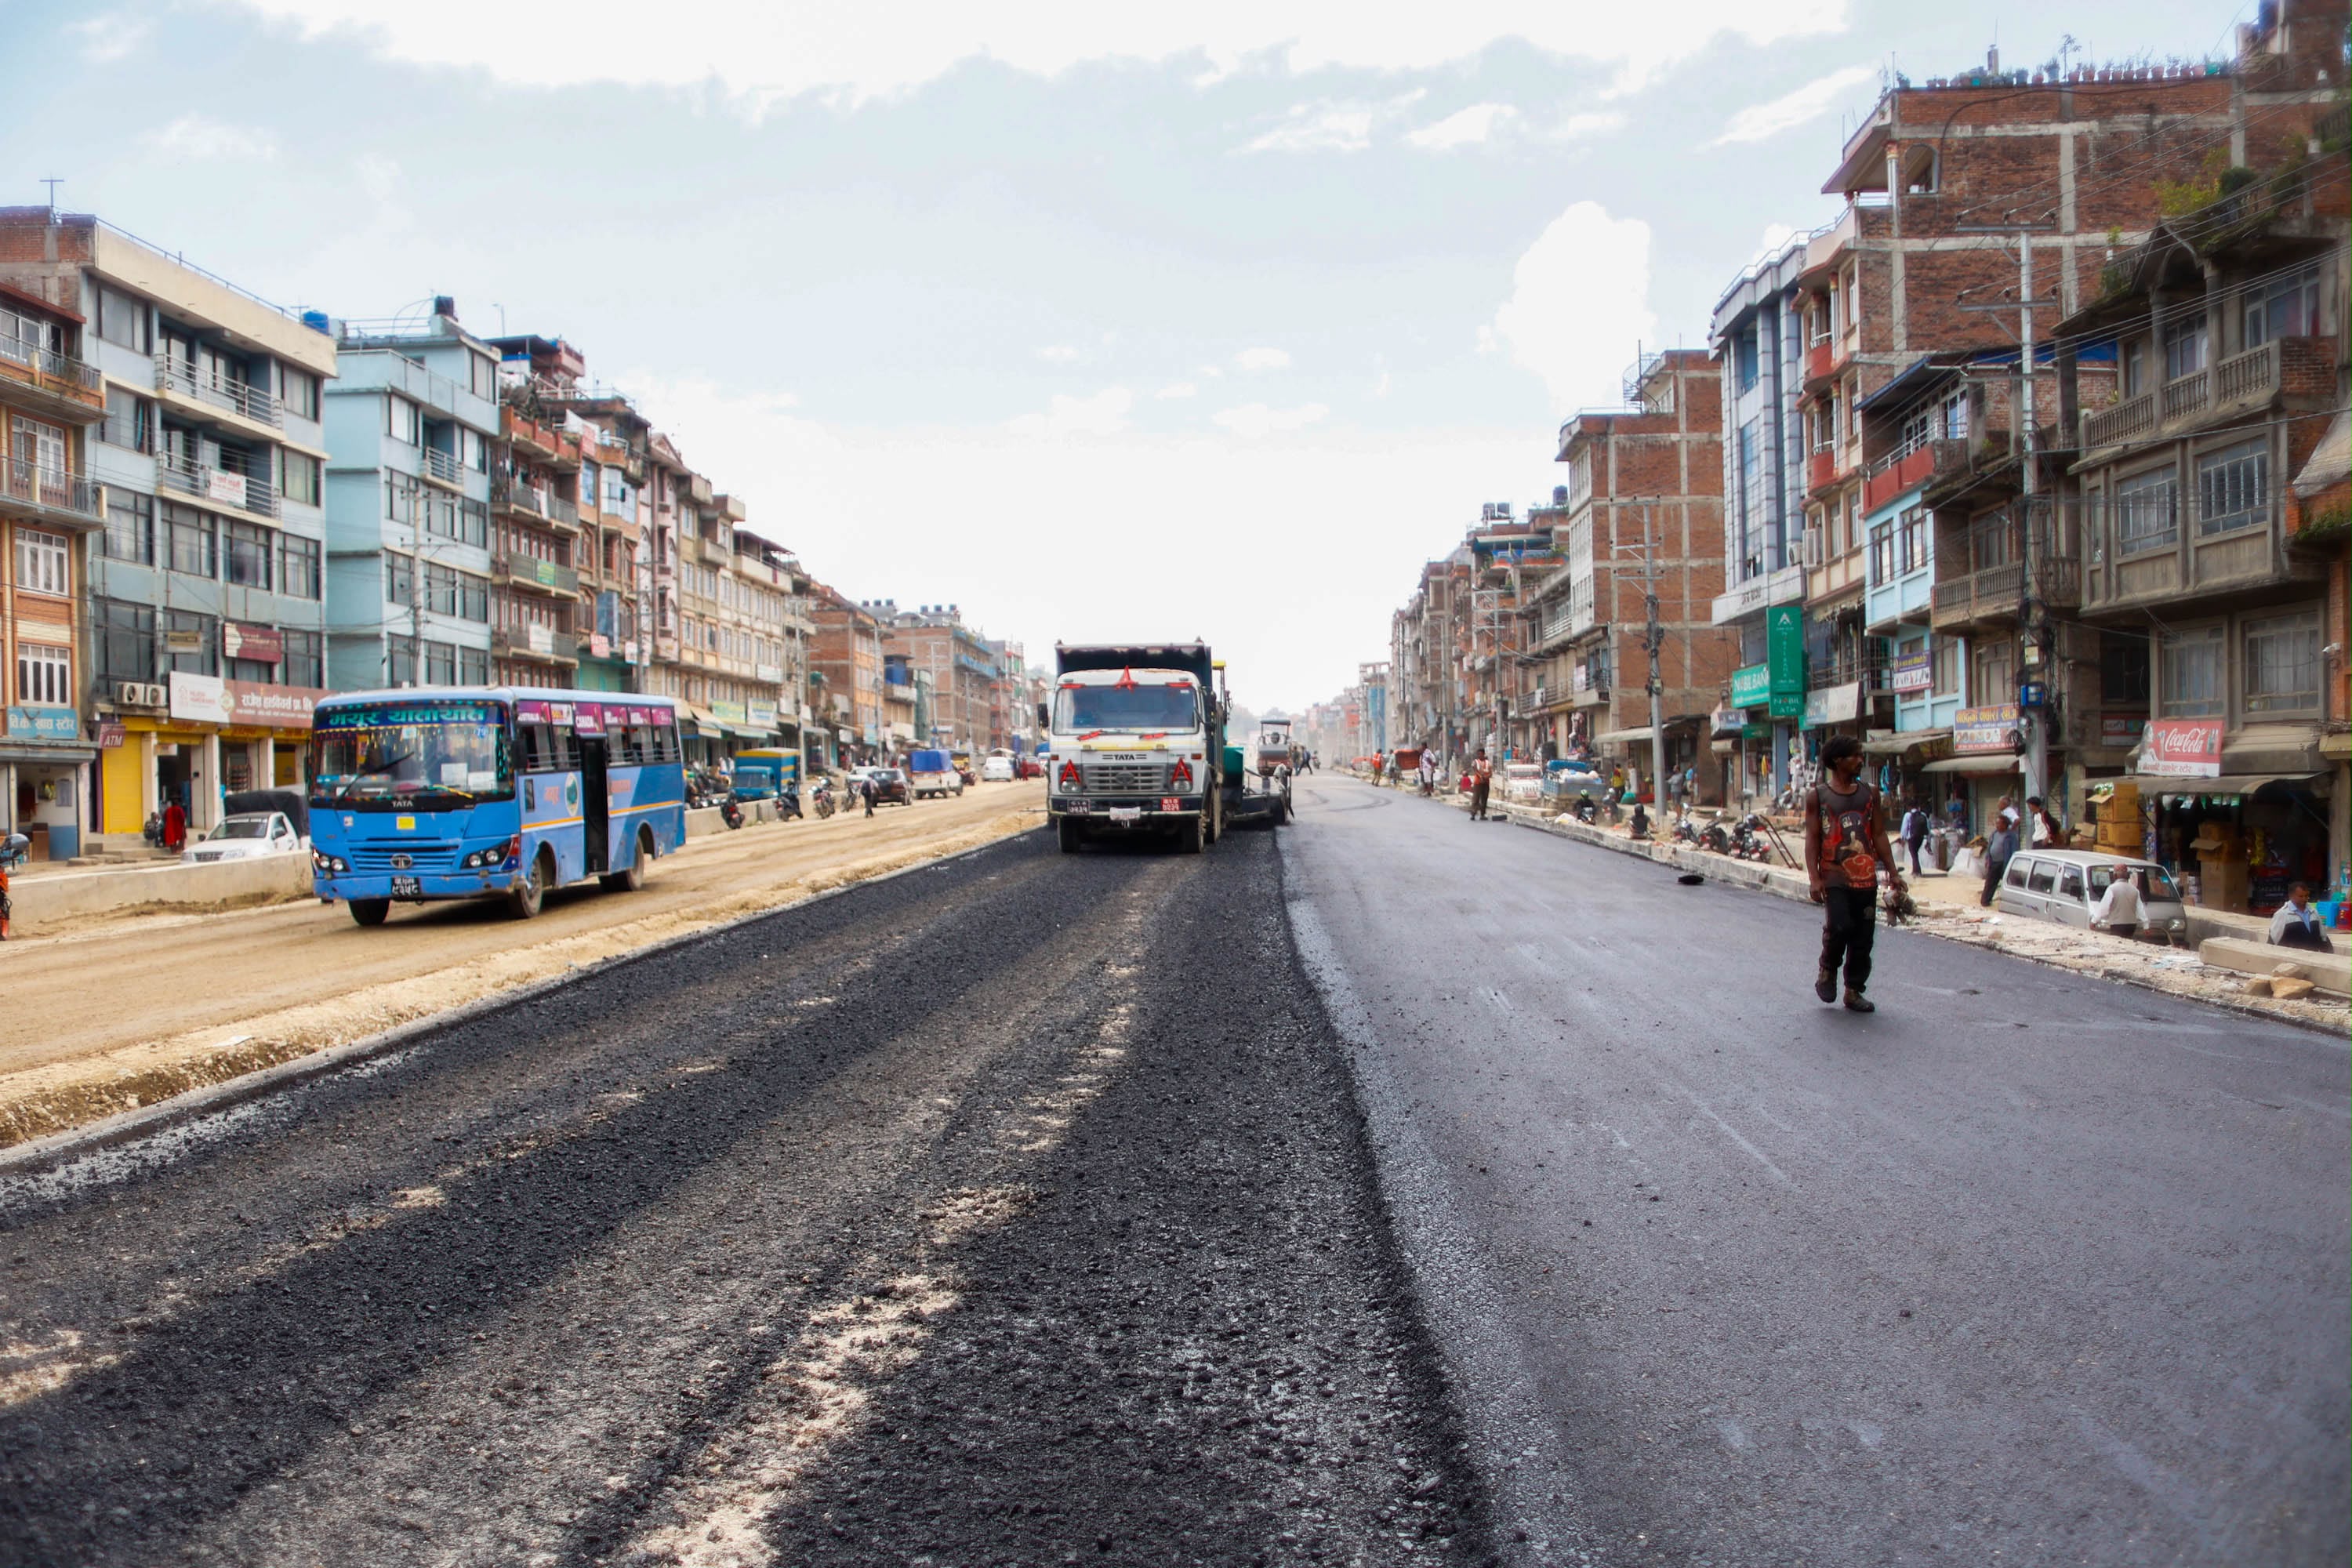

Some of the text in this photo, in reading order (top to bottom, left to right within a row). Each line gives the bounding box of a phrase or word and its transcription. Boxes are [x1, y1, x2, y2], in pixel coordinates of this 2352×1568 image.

[328, 710, 381, 728] मयूर
[387, 708, 487, 724] यातायात
[104, 735, 123, 747] ATM
